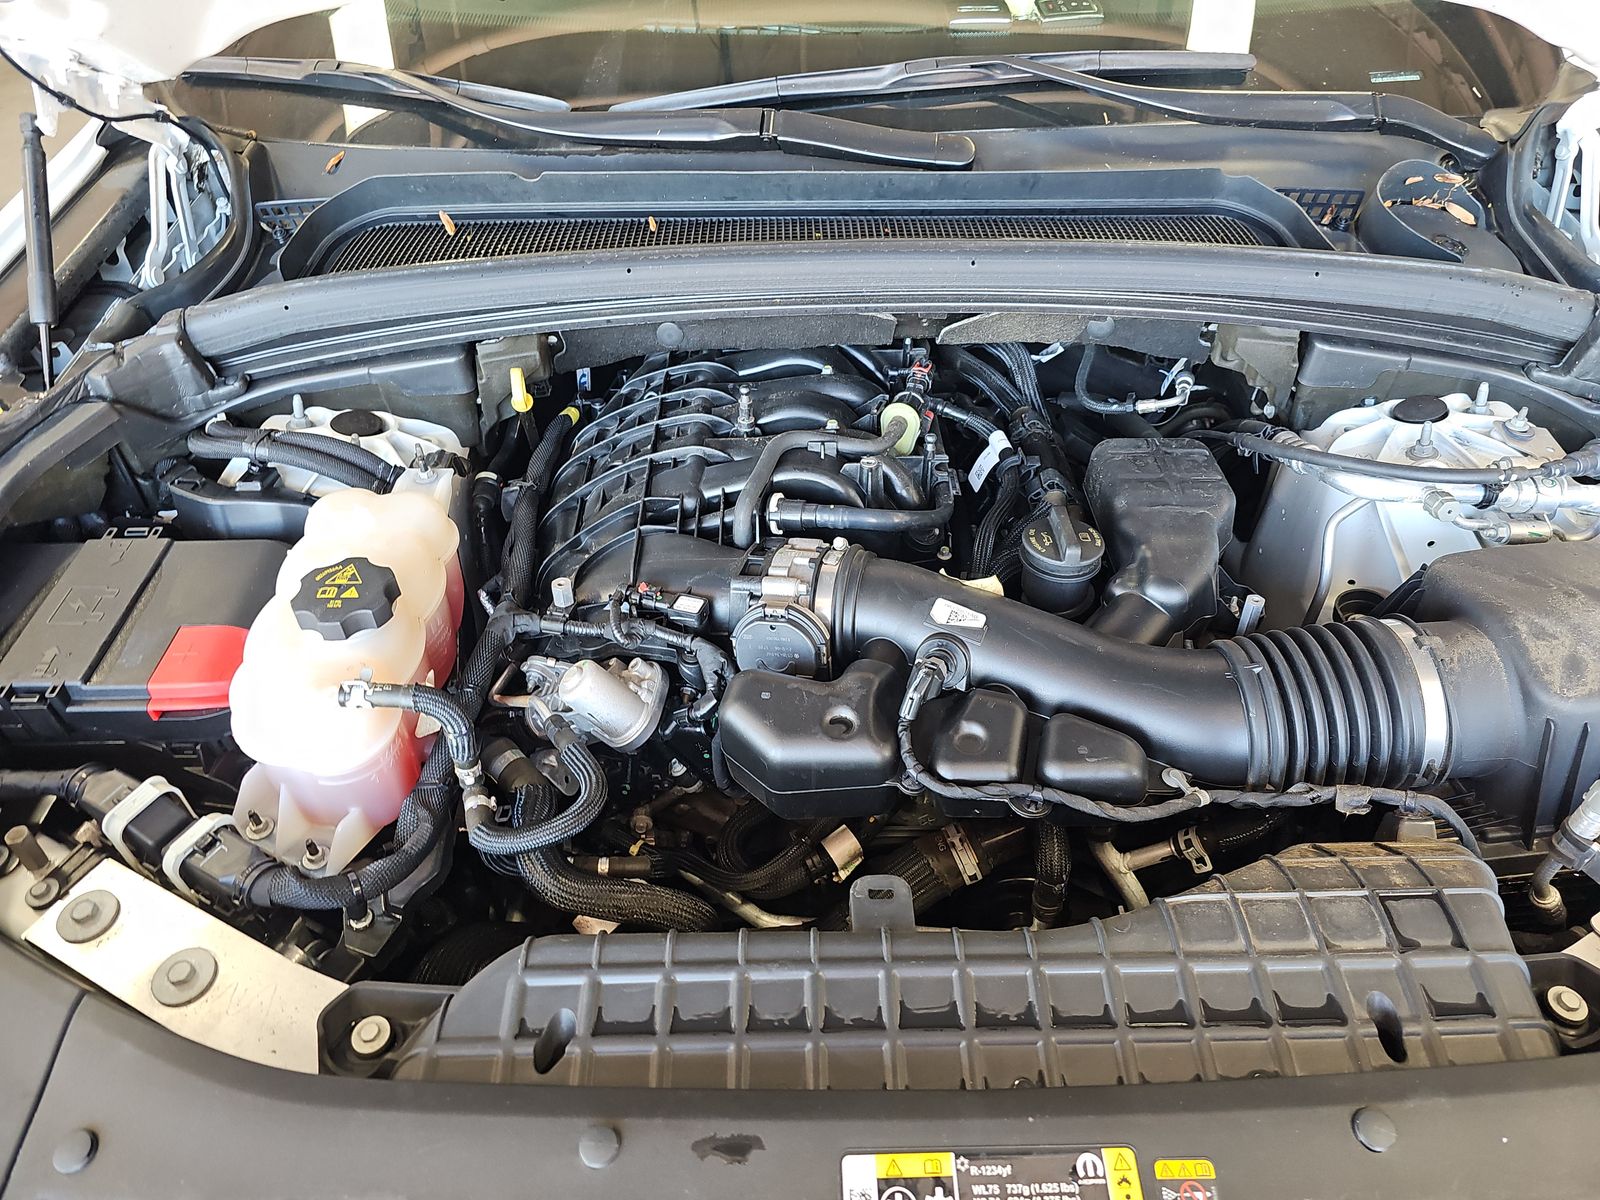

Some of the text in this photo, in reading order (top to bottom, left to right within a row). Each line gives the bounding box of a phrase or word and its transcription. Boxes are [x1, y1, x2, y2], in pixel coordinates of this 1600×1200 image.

[970, 1164, 1012, 1178] R-1234yf
[1005, 1183, 1030, 1197] 737g
[1030, 1182, 1060, 1196] (1.625
[1060, 1181, 1080, 1195] lbs)
